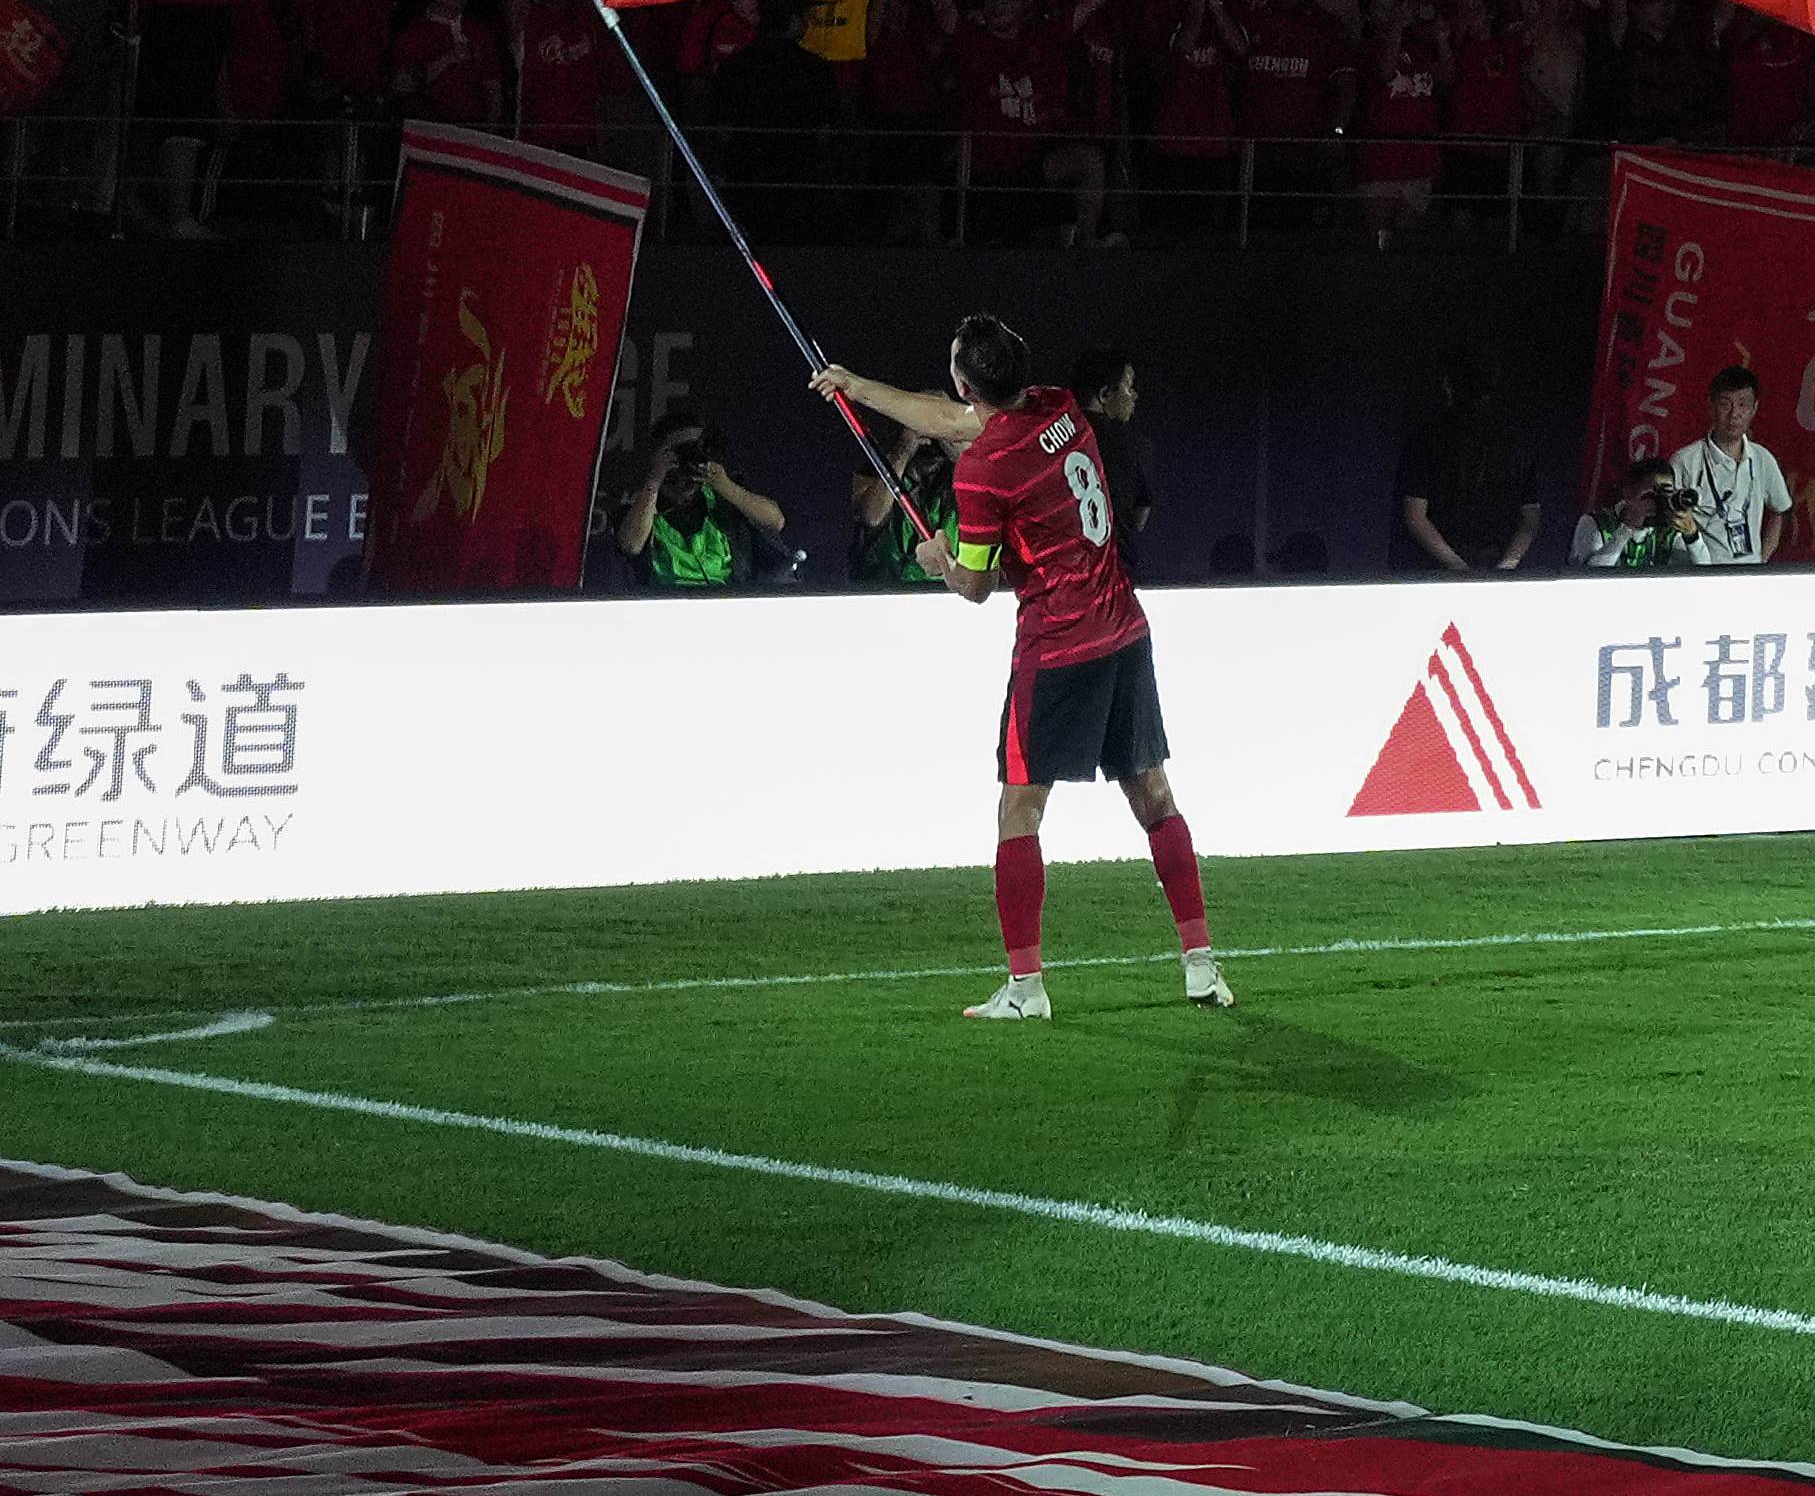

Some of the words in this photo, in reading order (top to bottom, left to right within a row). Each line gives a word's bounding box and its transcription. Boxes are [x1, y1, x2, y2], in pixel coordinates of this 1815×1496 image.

[1629, 241, 1705, 463] GUANG
[1038, 412, 1077, 456] CHOW
[130, 492, 330, 544] LEAGUE
[1063, 450, 1112, 548] 8
[1594, 753, 1743, 782] CHENGDU
